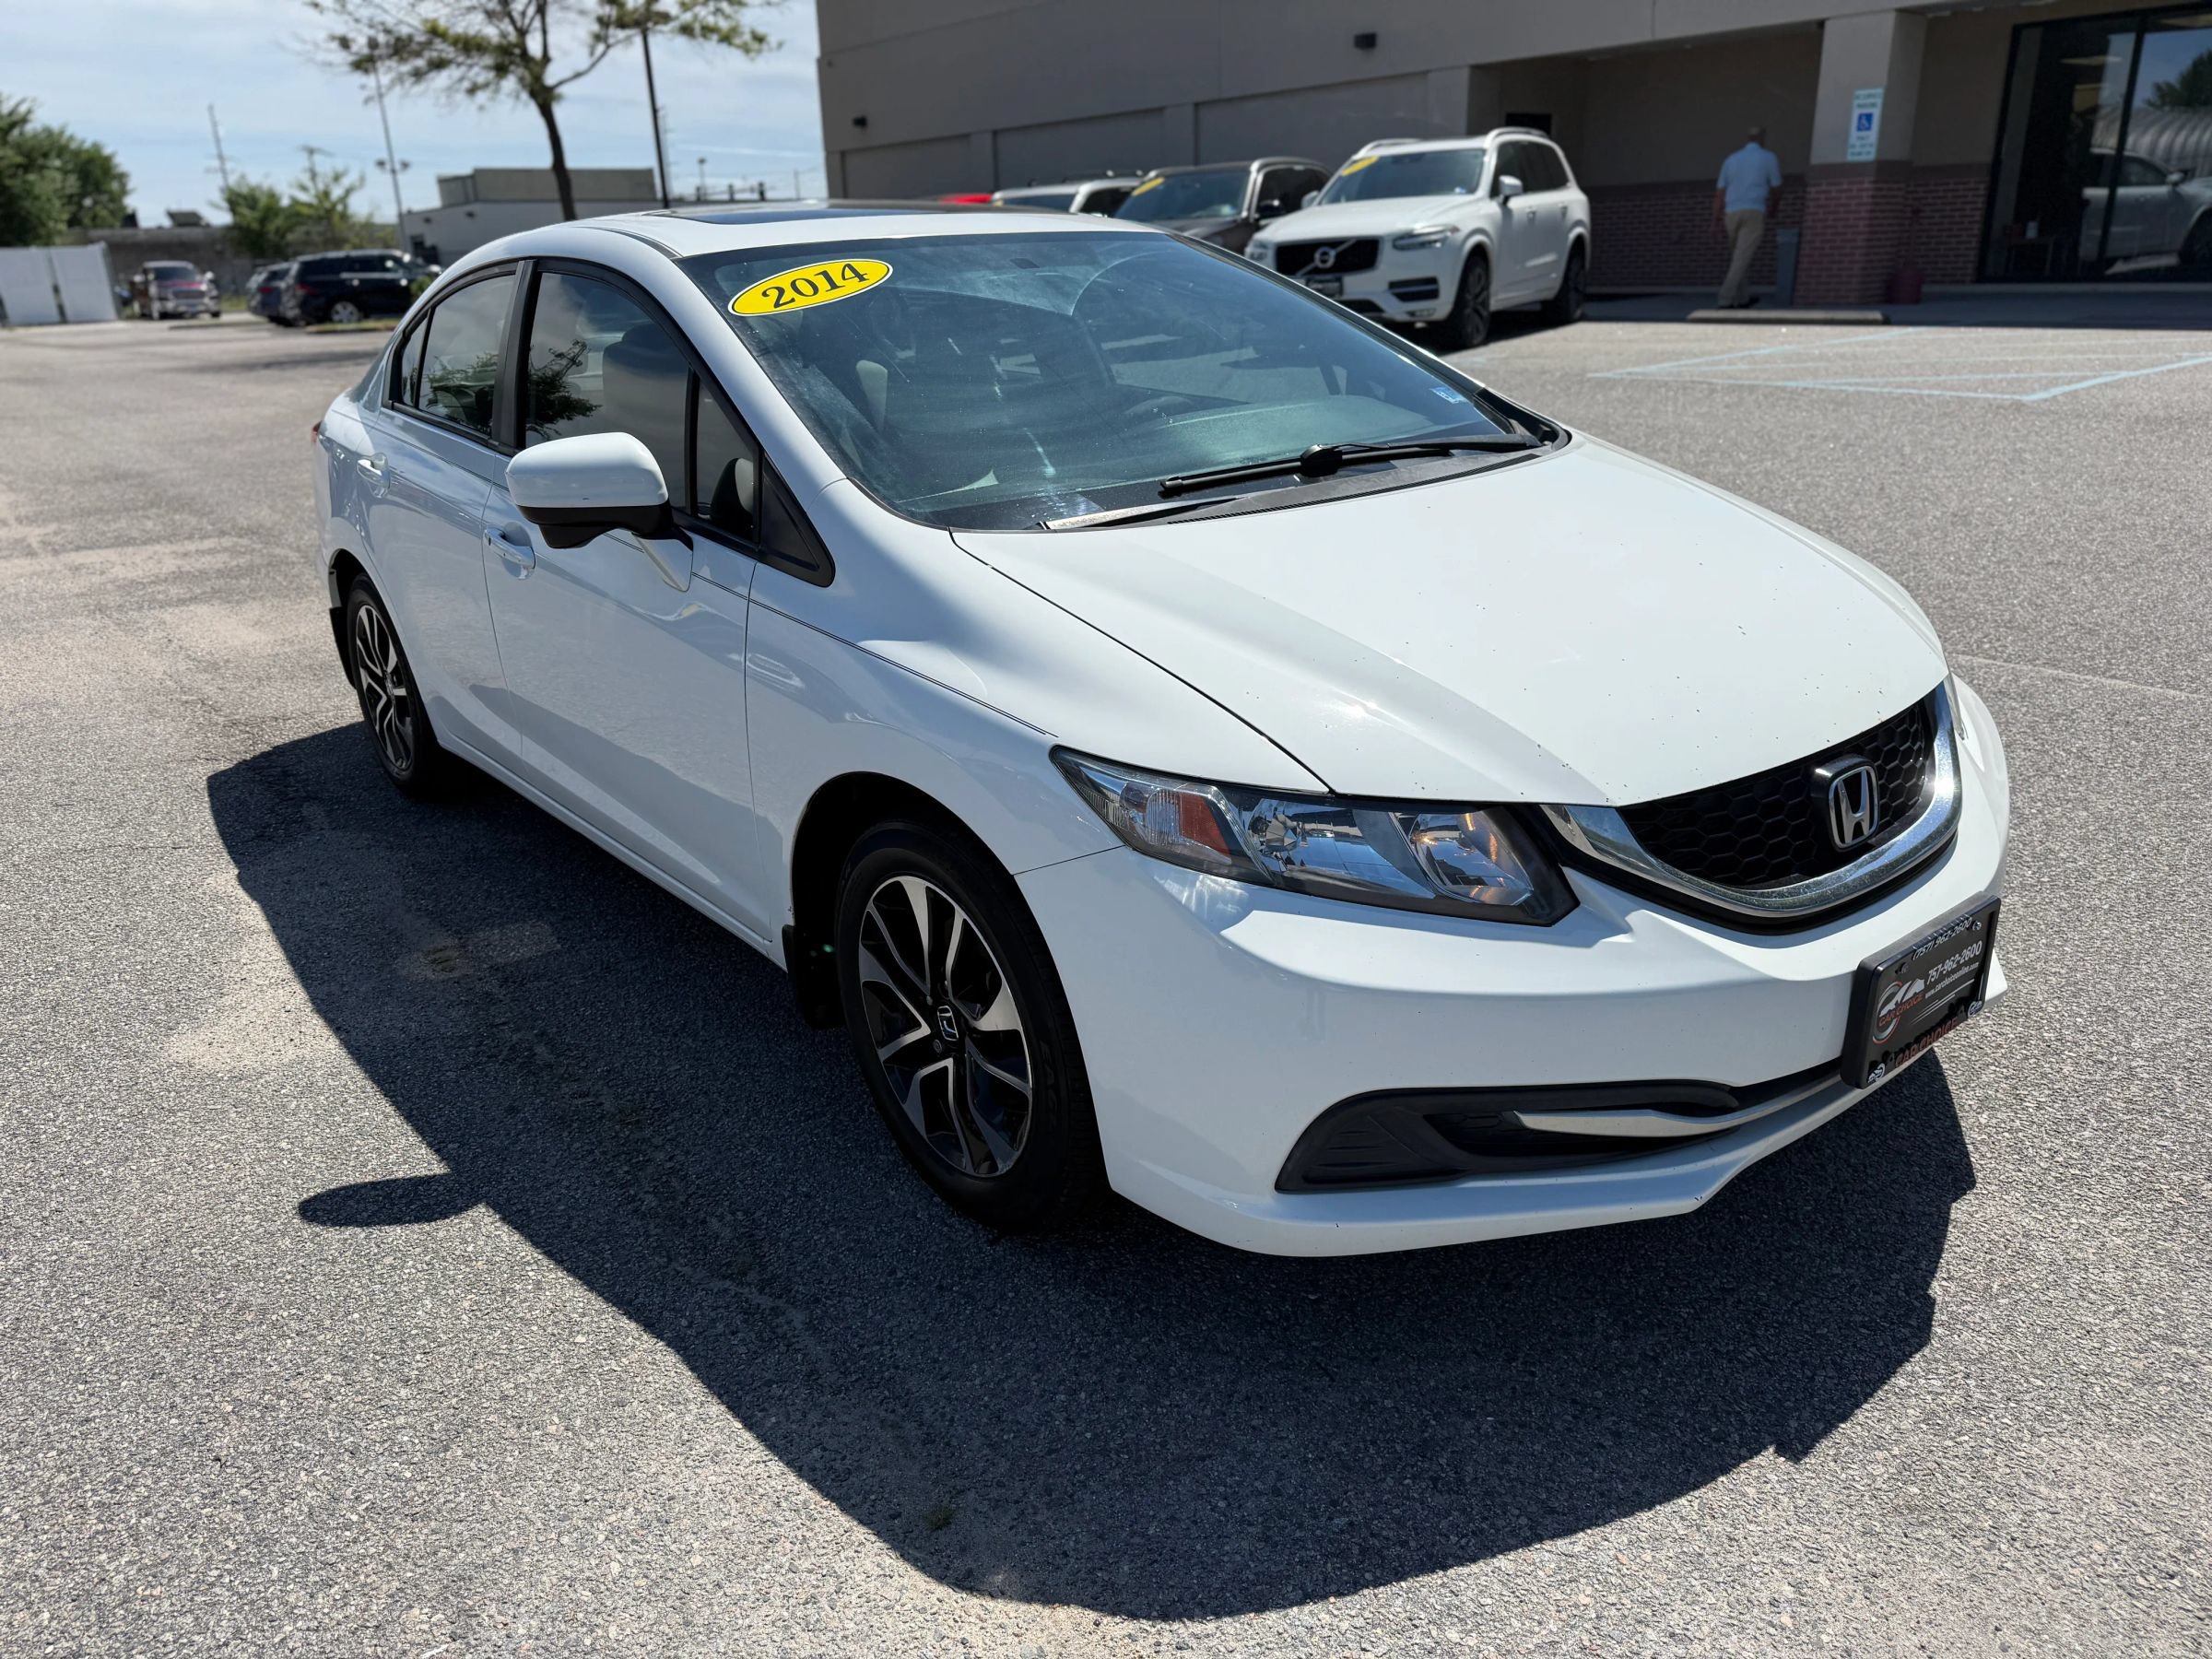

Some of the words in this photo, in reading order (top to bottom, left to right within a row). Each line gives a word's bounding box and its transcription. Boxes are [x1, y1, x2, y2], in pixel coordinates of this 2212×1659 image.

[761, 263, 870, 309] 2014
[1927, 940, 1983, 985] 757-962-2600
[1920, 1017, 1958, 1051] CHOICE
